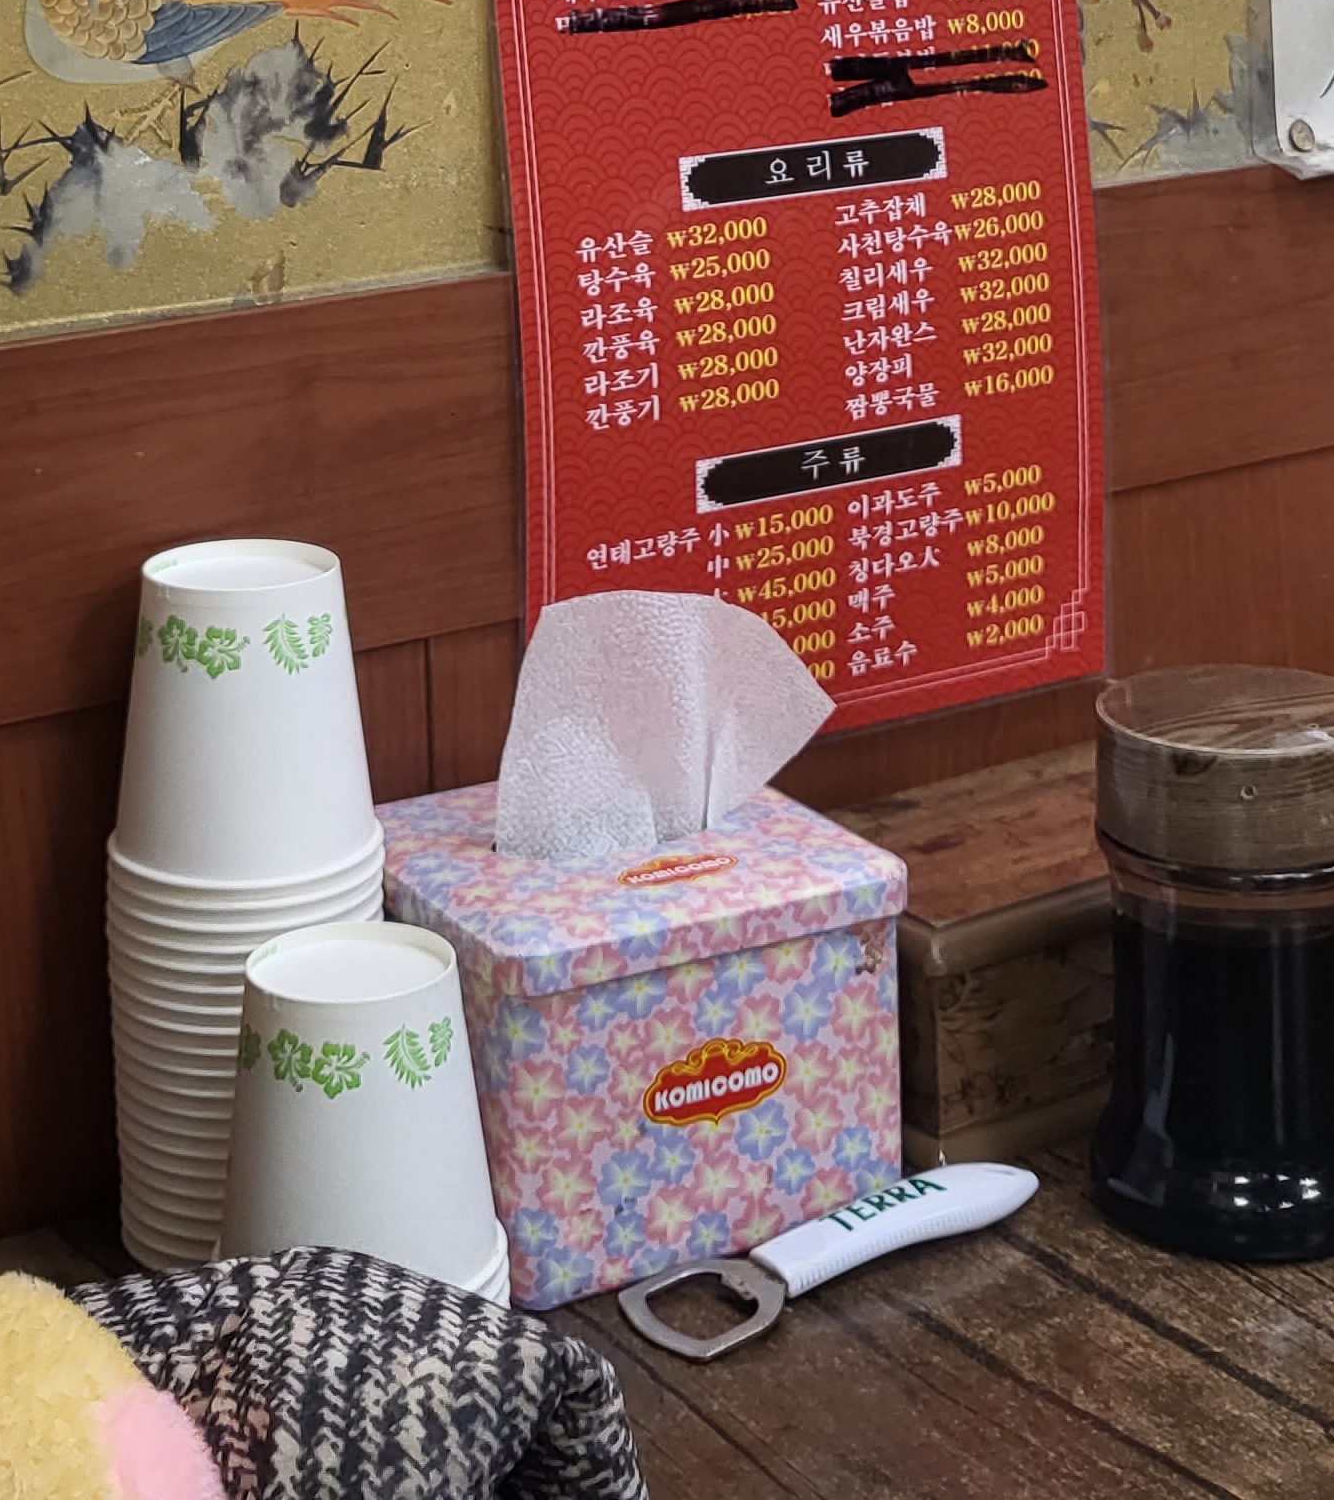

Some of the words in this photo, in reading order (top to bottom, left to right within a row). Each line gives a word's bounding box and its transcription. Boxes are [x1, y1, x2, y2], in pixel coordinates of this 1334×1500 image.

[820, 15, 936, 49] 새우볶음밥
[947, 9, 1024, 36] ₩8,000
[834, 192, 927, 227] 고추잡채
[950, 180, 1042, 210] ₩28,000
[575, 230, 653, 263] 유산슬
[666, 216, 767, 249] ₩32,000
[837, 220, 953, 259] 사천탕수육
[953, 210, 1044, 241] ₩26,000
[577, 262, 656, 297] 탕수육
[669, 248, 770, 281] ₩25,000
[838, 257, 933, 292] 칠리새우
[958, 242, 1048, 273] ₩32,000
[581, 296, 658, 330] 라조육
[673, 281, 774, 315] ₩28,000
[841, 288, 935, 322] 크림새우
[960, 272, 1050, 304] ₩32,000
[582, 329, 660, 364] 깐풍육
[675, 313, 776, 347] ₩28,000
[842, 321, 938, 356] 난자완스
[962, 303, 1052, 335] ₩28,000
[584, 362, 660, 397] 라조기
[677, 346, 778, 380] ₩28,000
[844, 353, 913, 388] 양장피
[963, 333, 1053, 366] ₩32,000
[585, 394, 661, 431] 깐풍기
[679, 378, 780, 413] ₩28,000
[845, 382, 940, 421] 짬뽕국물
[964, 365, 1055, 399] ₩16,000
[800, 446, 866, 481] 주류
[847, 481, 943, 520] 이과도주
[964, 464, 1043, 497] ₩5,000
[848, 507, 965, 551] 북경고량주
[965, 491, 1055, 528] ₩10,000
[966, 525, 1046, 558] ₩8,000
[586, 526, 701, 571] 연태고량주
[847, 582, 897, 614] 맥주
[966, 554, 1045, 588] ₩5,000
[846, 614, 896, 644] 소주
[966, 584, 1045, 619] ₩4,000
[847, 640, 918, 677] 음료수
[966, 614, 1045, 649] ₩2,000
[653, 1061, 780, 1114] KOMICOMO
[818, 1174, 948, 1234] TERRA
